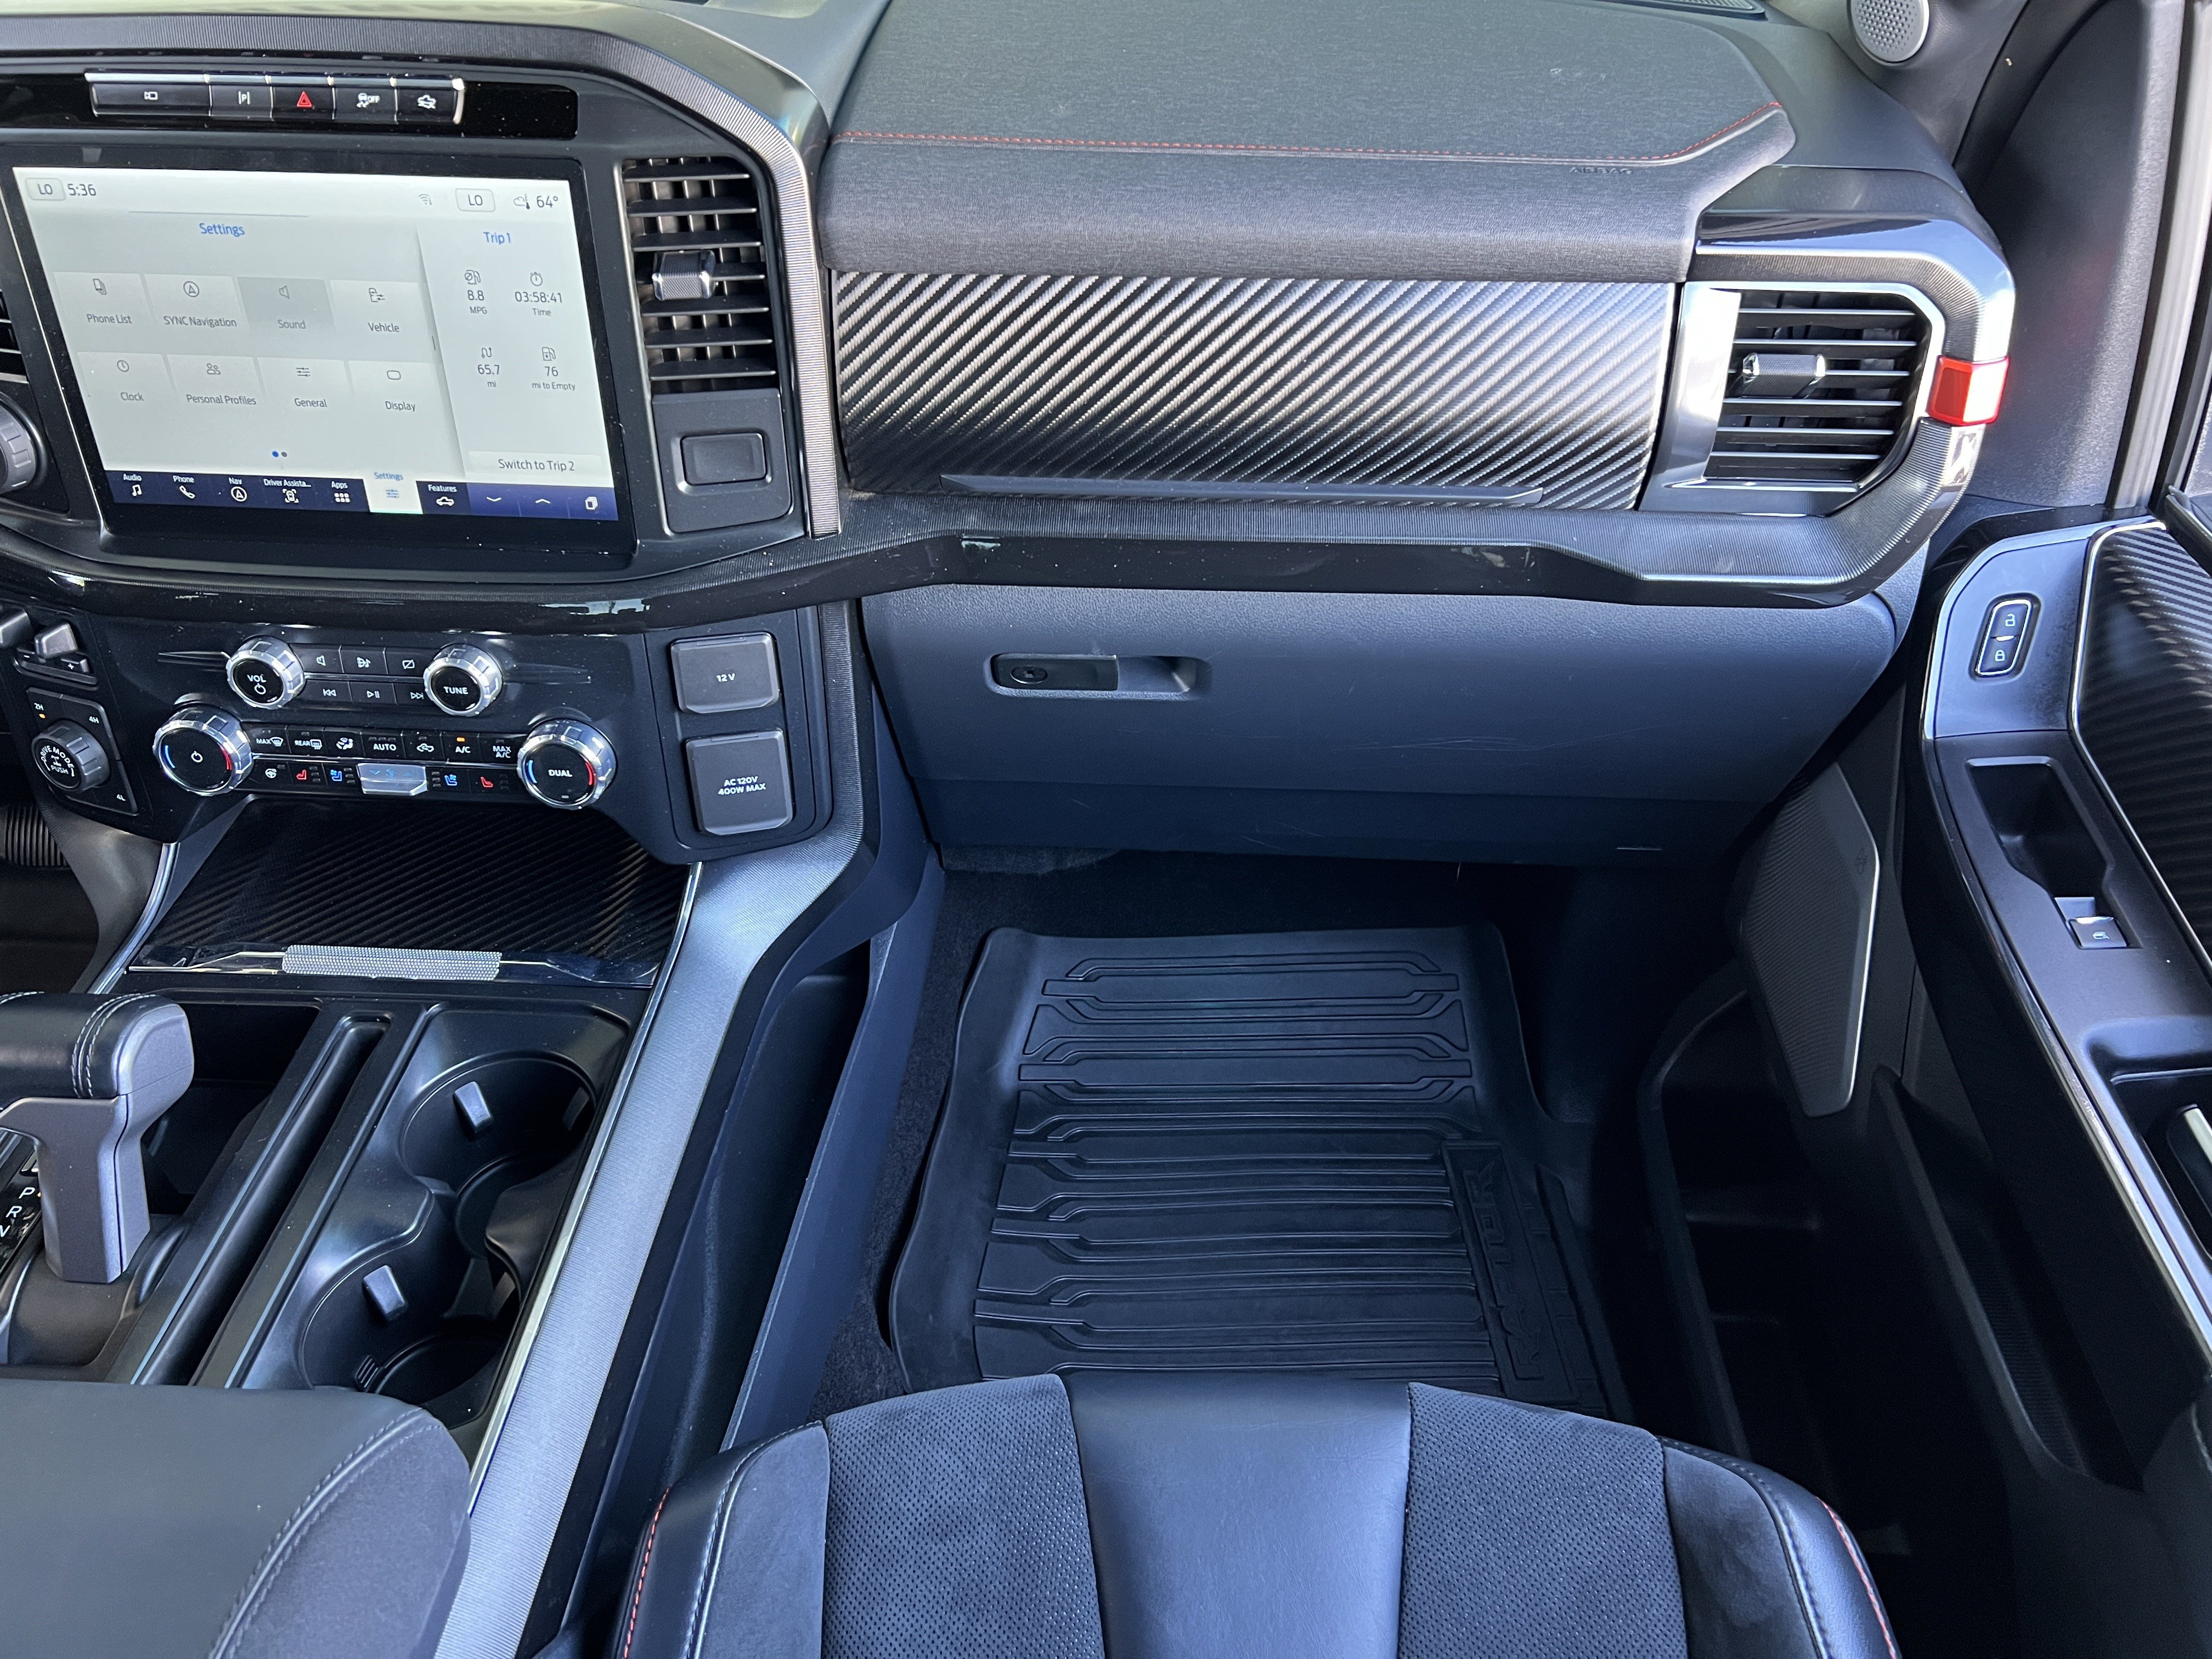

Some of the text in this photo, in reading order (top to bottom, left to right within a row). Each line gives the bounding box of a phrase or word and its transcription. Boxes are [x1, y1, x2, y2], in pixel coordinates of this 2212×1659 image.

[367, 95, 380, 103] OFF
[38, 184, 53, 195] LO
[67, 183, 97, 196] 5:36
[468, 195, 483, 206] LO
[537, 195, 558, 208] 64°
[199, 223, 245, 237] Settings
[483, 232, 511, 245] Trip 1
[467, 290, 484, 301] 8.8
[515, 291, 563, 304] 03:58:41
[470, 306, 488, 315] MPG
[532, 308, 551, 317] Time
[87, 313, 132, 324] Phone List
[163, 315, 237, 328] SYNC Navigation
[278, 319, 306, 330] Sound
[368, 323, 400, 333] Vehicle
[477, 364, 500, 376] 65.7
[545, 366, 558, 377] 76
[551, 382, 575, 392] Empty
[120, 391, 144, 402] Clock
[186, 394, 257, 405] Personal Profiles
[295, 397, 327, 408] General
[385, 400, 416, 412] Display
[498, 459, 575, 472] Switch to Trip 2
[123, 473, 142, 482] Audio
[173, 475, 194, 484] Phone
[228, 477, 242, 485] Nav
[374, 471, 404, 482] Settings
[263, 478, 283, 487] Driver
[331, 481, 348, 490] Apps
[428, 484, 457, 493] Features
[247, 674, 267, 684] VOL
[716, 673, 736, 682] 12 V
[443, 686, 469, 695] TUNE
[455, 745, 471, 754] A/C
[40, 745, 75, 768] DRIVE MODE
[50, 765, 69, 775] PUSH
[549, 769, 573, 777] DUAL
[724, 775, 759, 787] AC 120V
[718, 782, 766, 796] 400W MAX
[19, 1187, 35, 1199] P
[5, 1205, 22, 1217] R
